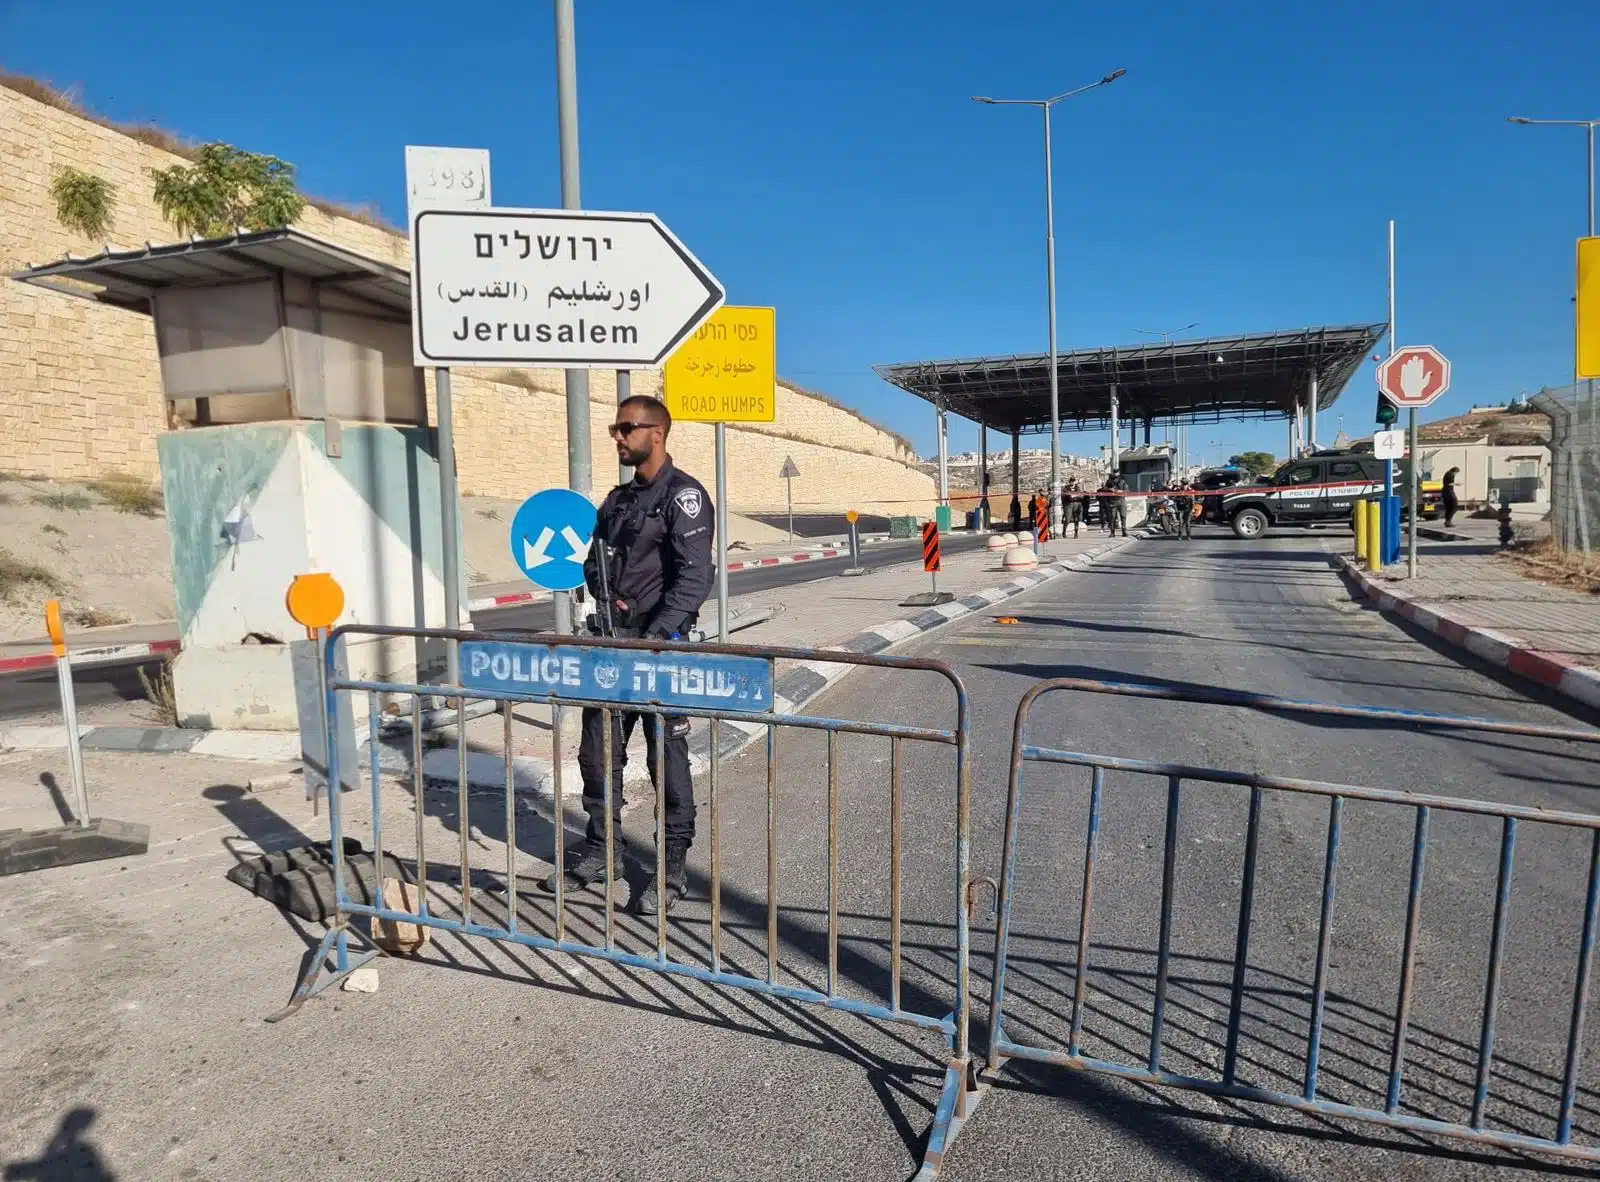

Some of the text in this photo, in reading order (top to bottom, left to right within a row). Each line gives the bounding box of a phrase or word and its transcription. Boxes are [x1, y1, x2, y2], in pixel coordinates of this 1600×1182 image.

[474, 230, 612, 261] ירושלים
[437, 280, 649, 311] اورشليم (القدس)
[453, 316, 638, 344] Jerusalem
[694, 322, 758, 341] פסי הרע
[681, 395, 765, 413] ROAD HUMPS
[1382, 433, 1395, 450] 4
[470, 650, 581, 686] POLICE
